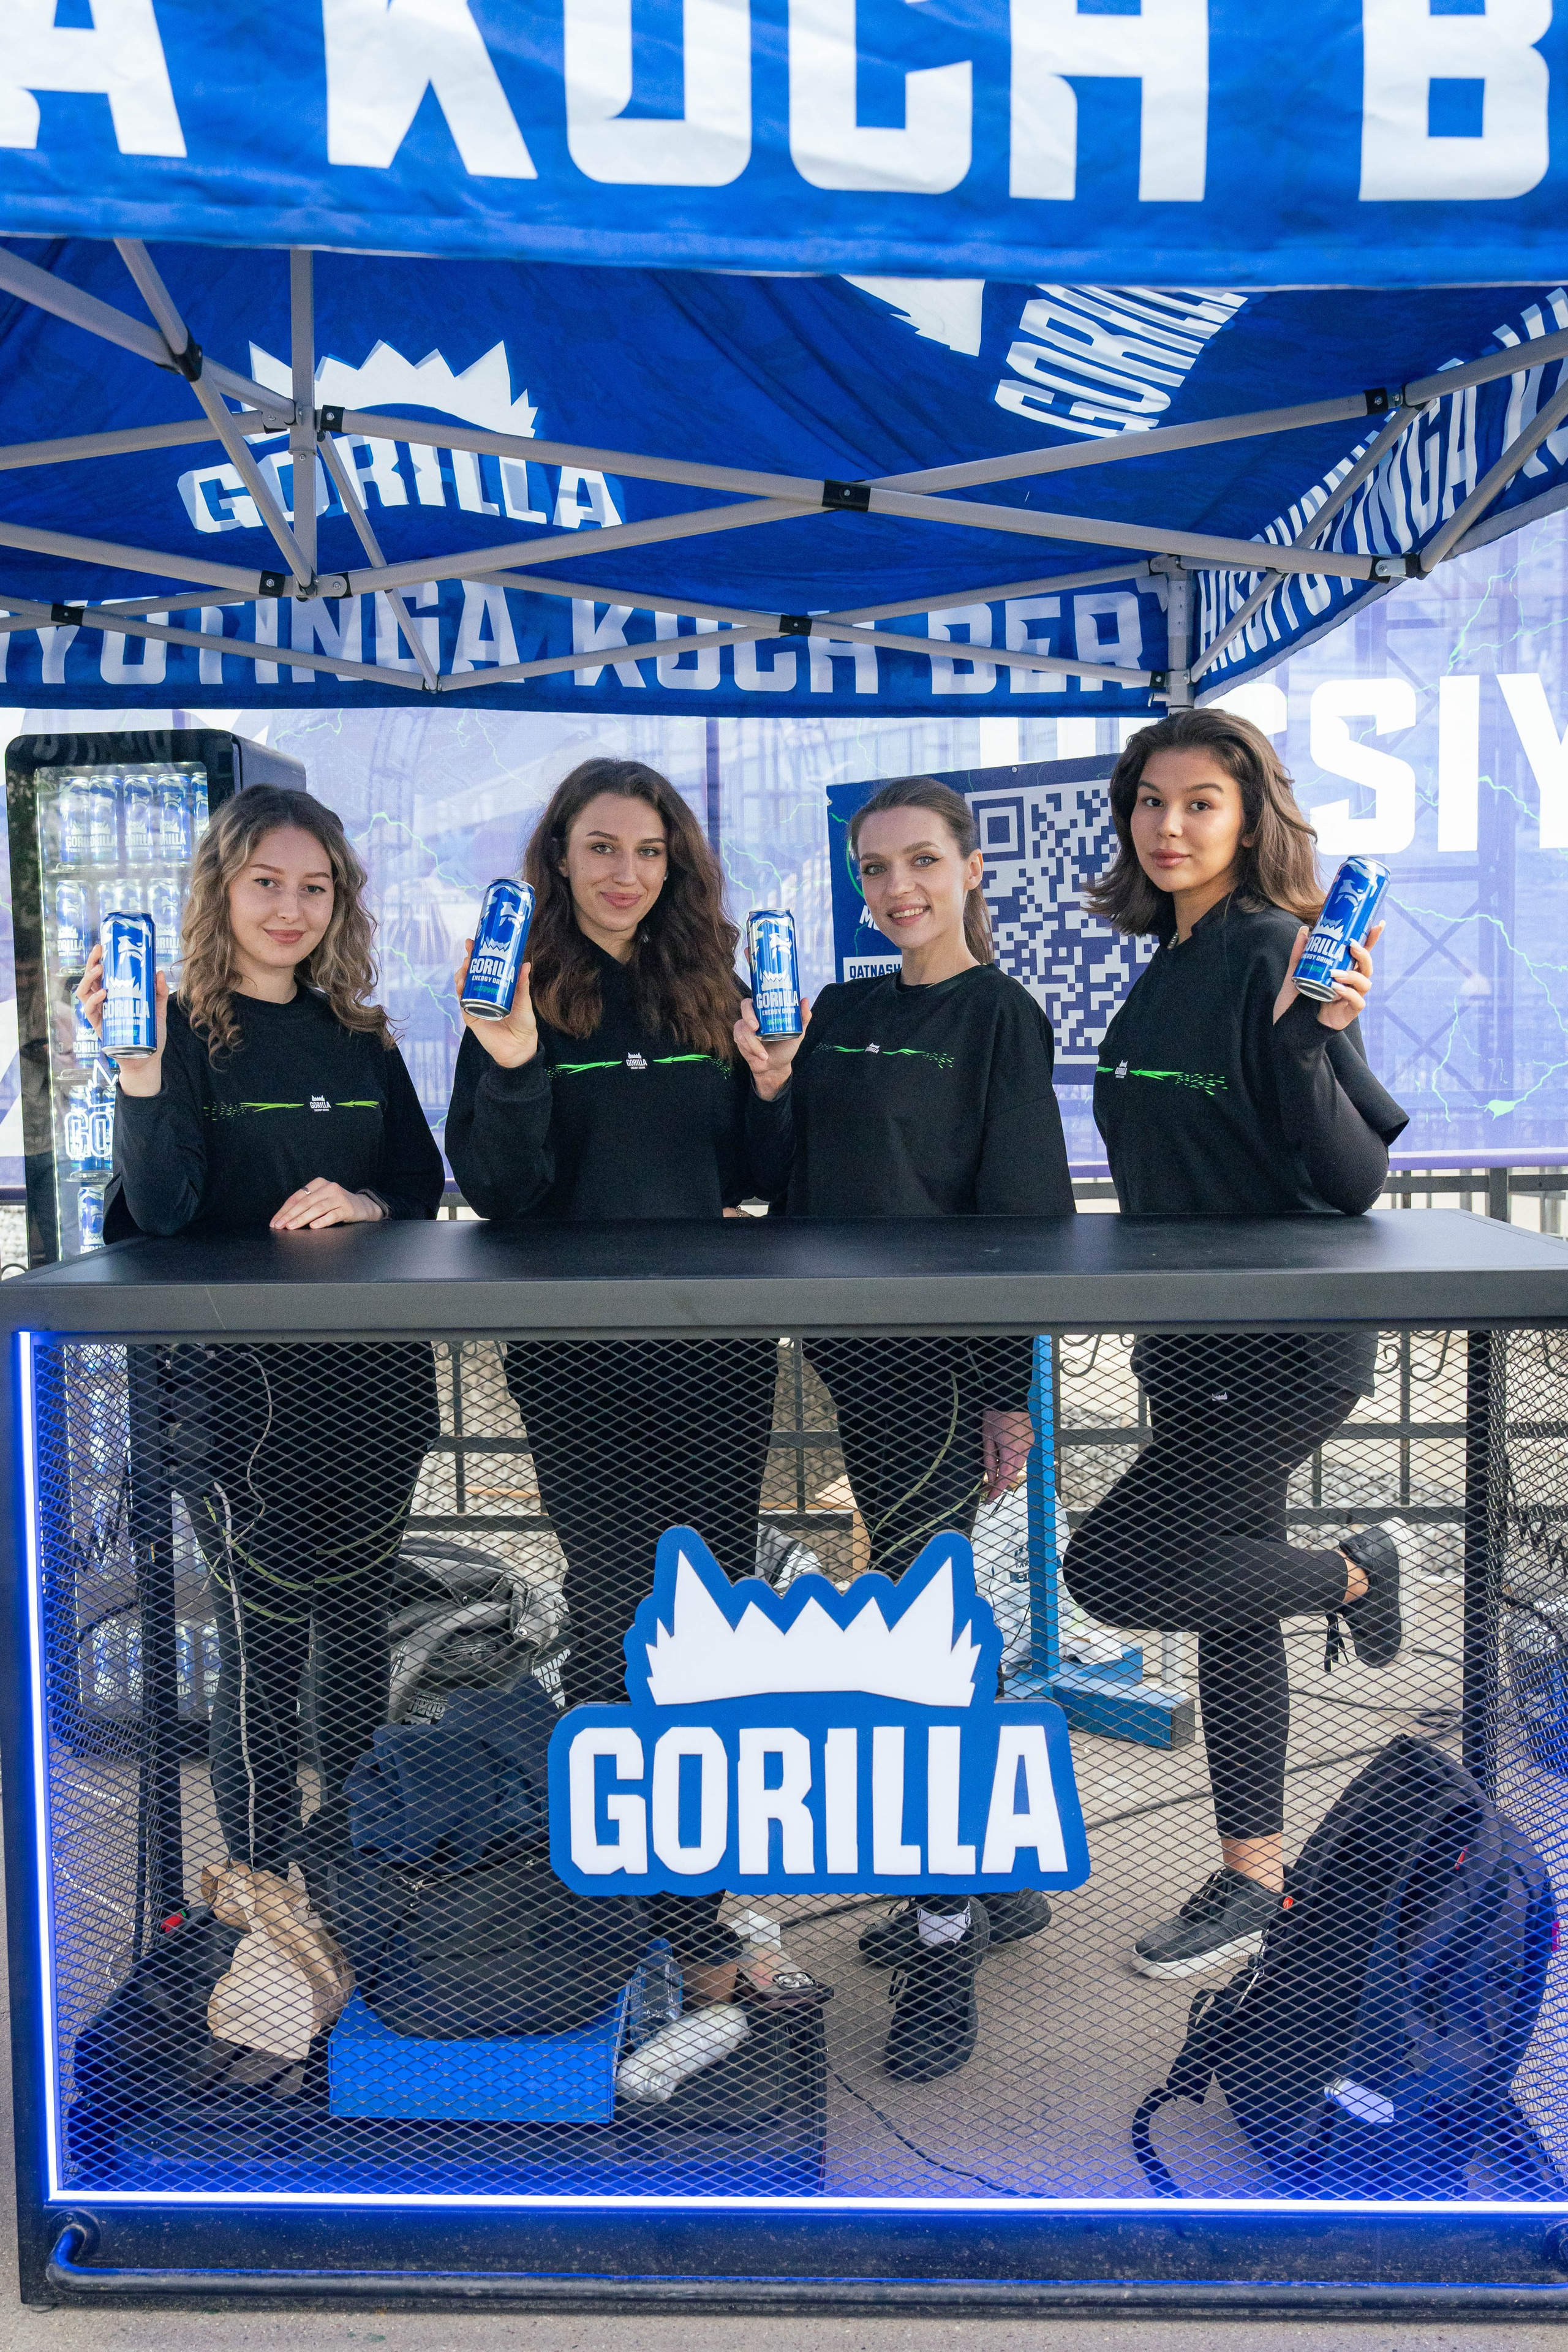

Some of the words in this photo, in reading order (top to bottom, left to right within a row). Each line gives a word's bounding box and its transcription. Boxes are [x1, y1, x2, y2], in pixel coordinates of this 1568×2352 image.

[177, 429, 624, 534] GORILLA
[572, 597, 878, 694] KUCH
[928, 591, 1143, 695] BER
[1305, 936, 1346, 962] ORILLA
[470, 957, 515, 983] GORILLA
[102, 1000, 150, 1020] GORILLA
[756, 990, 799, 1009] GORILLA
[73, 1041, 101, 1053] GORILL
[569, 1725, 1068, 1875] GORILLA
